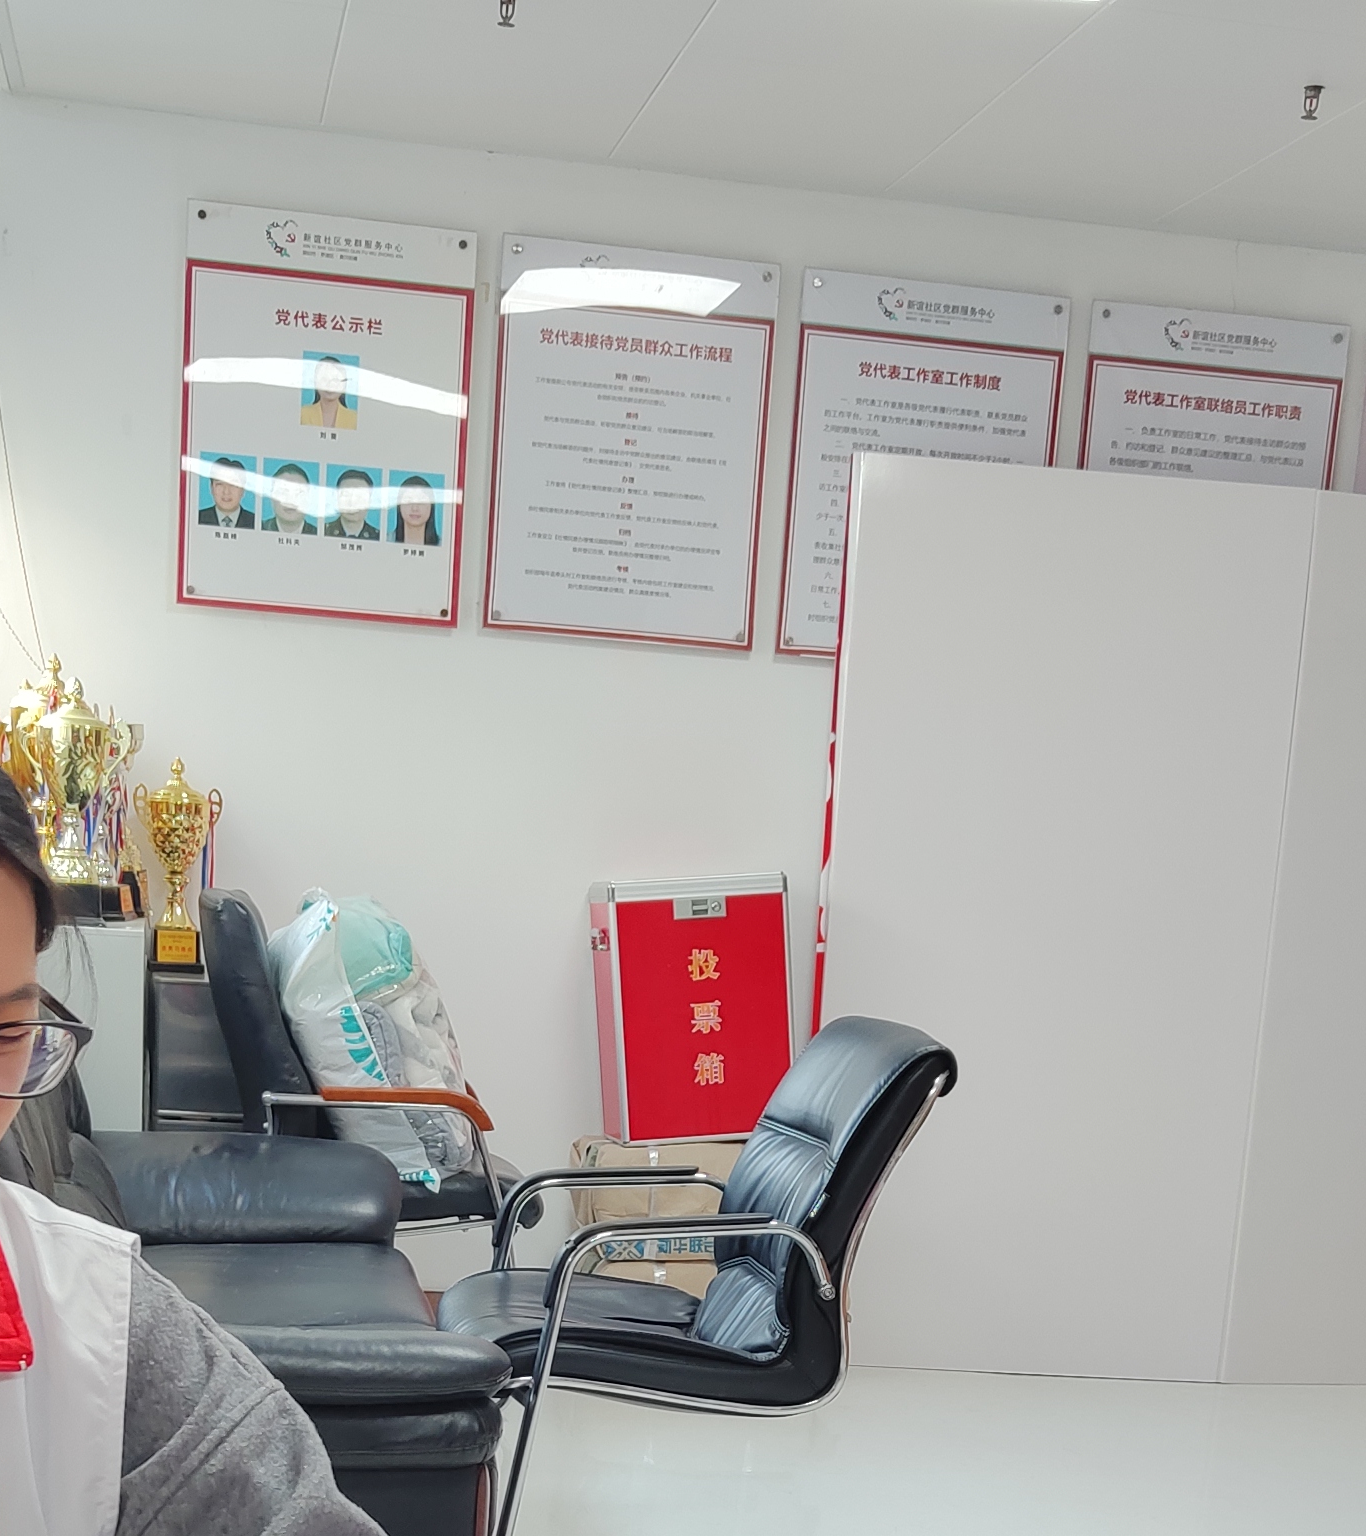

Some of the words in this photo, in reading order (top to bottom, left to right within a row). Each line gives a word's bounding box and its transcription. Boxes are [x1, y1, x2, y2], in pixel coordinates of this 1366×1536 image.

[275, 308, 384, 336] 党代表公示栏
[539, 327, 734, 364] 党代表接待党员群众工作流程
[858, 361, 1002, 391] 党代表工作室工作制度
[1123, 388, 1303, 421] 党代表工作室联络员工作职责
[688, 948, 725, 1086] 投票箱
